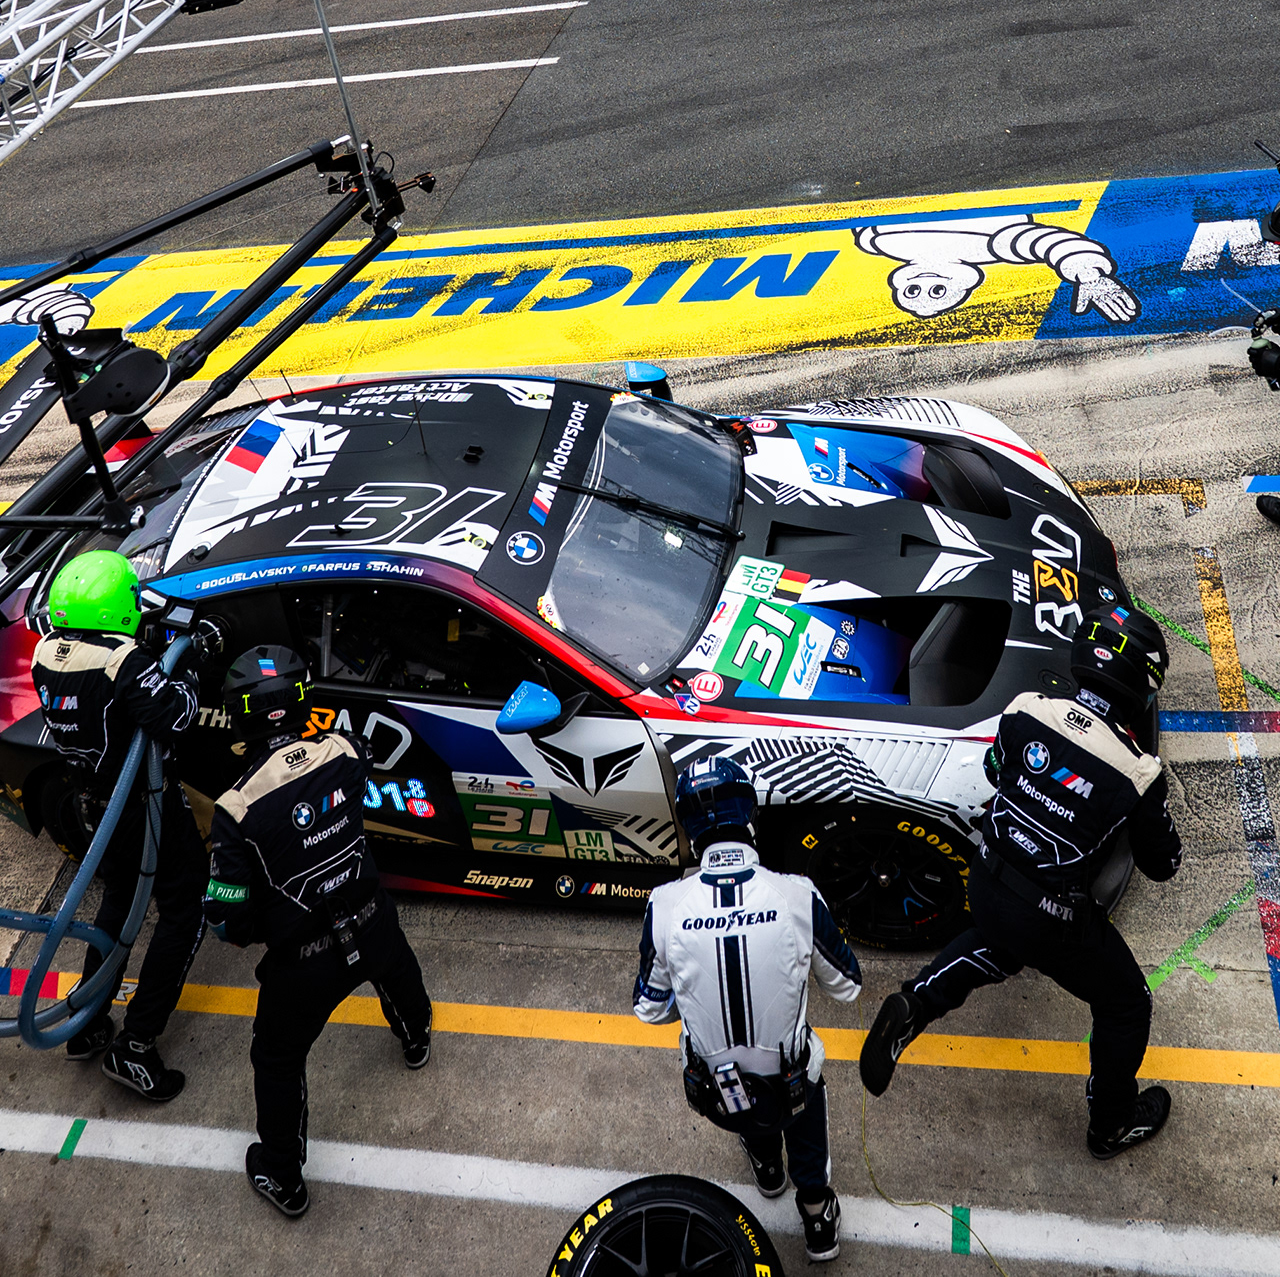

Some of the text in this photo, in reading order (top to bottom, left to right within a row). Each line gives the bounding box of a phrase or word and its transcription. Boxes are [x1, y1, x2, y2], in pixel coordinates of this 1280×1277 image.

[548, 400, 590, 480] Motorsport
[836, 446, 847, 486] Motorsport
[287, 481, 506, 550] 31
[200, 562, 424, 589] BOGUSLAVSKIY FARFUS SHAHIN
[740, 564, 757, 586] LM
[752, 566, 778, 594] GT3
[1011, 568, 1031, 605] THE
[696, 633, 716, 657] 24h
[731, 602, 797, 689] 31
[1066, 711, 1093, 729] OMP
[283, 748, 309, 766] OMP
[1017, 774, 1075, 823] Motorsport
[303, 815, 350, 849] Motorsport
[472, 803, 550, 836] 31
[492, 841, 545, 854] WEC
[574, 831, 604, 847] LM
[1012, 828, 1042, 855] WRT
[574, 847, 610, 861] GT3
[322, 867, 352, 893] WRT
[464, 869, 534, 890] Snap-on
[611, 884, 653, 899] Motors
[216, 886, 247, 900] PITLANE
[682, 908, 777, 932] GOODYEAR
